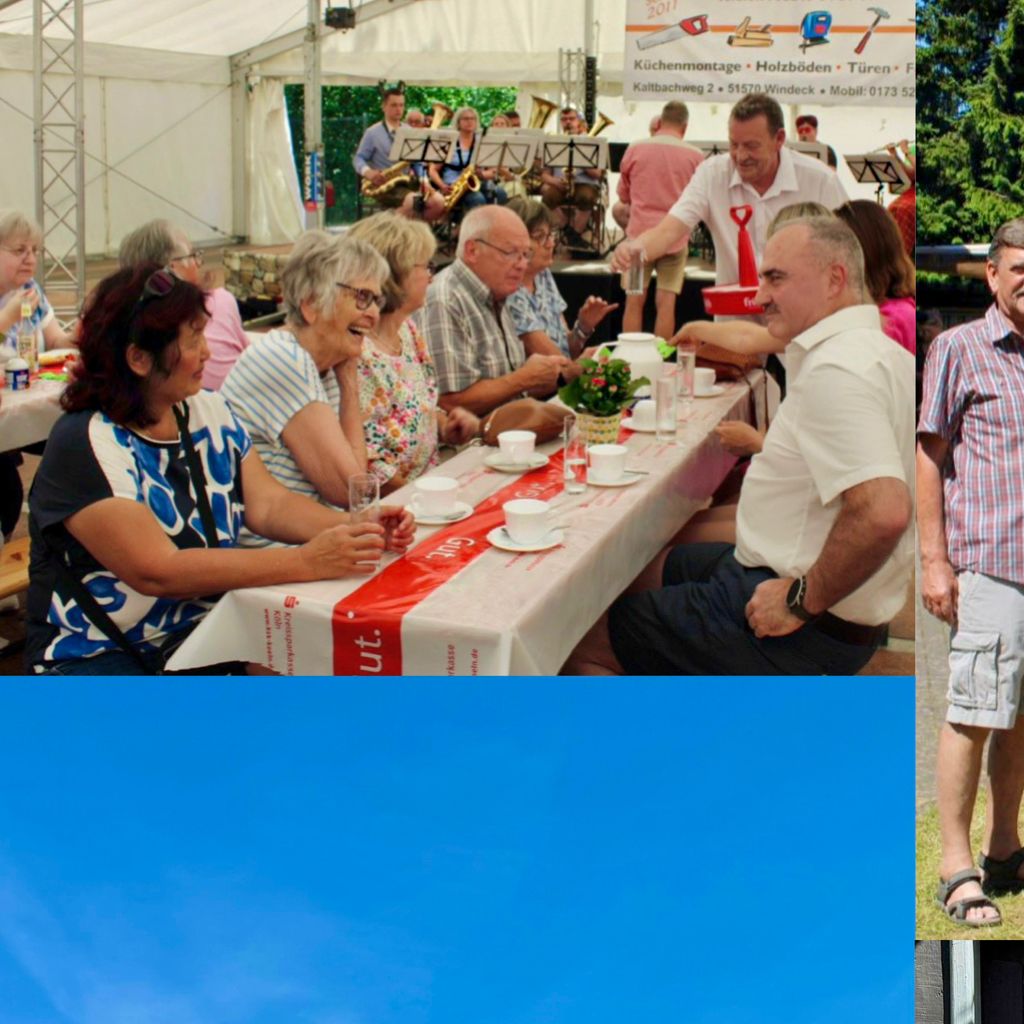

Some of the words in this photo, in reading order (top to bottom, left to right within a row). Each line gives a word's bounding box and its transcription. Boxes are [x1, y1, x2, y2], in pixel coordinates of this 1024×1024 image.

[633, 59, 742, 74] Küchenmontage
[755, 60, 832, 73] Holzböden
[847, 61, 891, 74] Türen
[633, 83, 704, 96] Kaltbachweg
[706, 83, 715, 94] 2
[727, 83, 761, 94] 51570
[763, 84, 816, 96] Windeck
[829, 85, 866, 97] Mobil:
[868, 86, 898, 97] 0173
[354, 629, 383, 676] ut.
